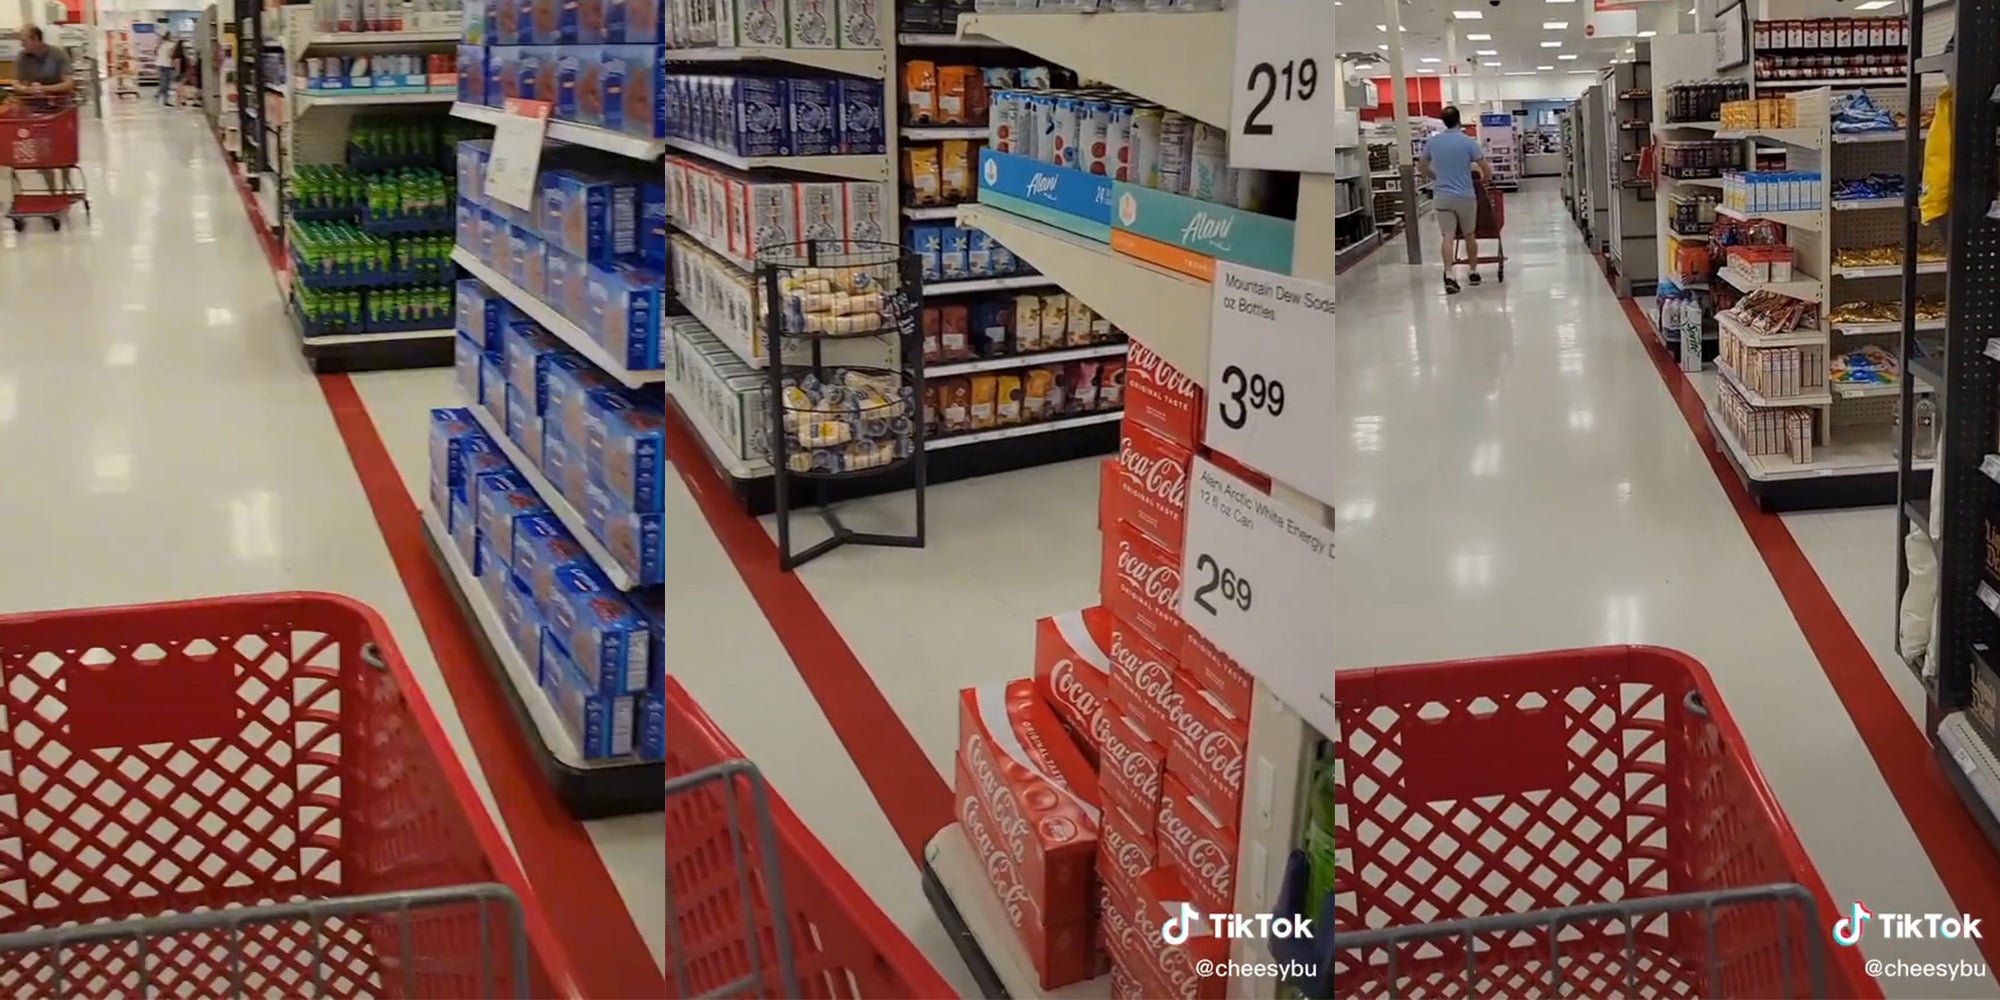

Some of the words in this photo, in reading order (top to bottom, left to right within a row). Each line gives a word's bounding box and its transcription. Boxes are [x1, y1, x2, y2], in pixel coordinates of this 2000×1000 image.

[1026, 172, 1060, 200] Alani
[1181, 211, 1234, 251] Alani
[1225, 272, 1273, 297] Mountain
[1275, 285, 1300, 304] Dew
[1223, 297, 1236, 310] oz
[1238, 298, 1275, 321] Bottles
[1685, 321, 1701, 358] Sprite
[1200, 488, 1211, 505] 12
[1233, 508, 1255, 531] Can
[1223, 483, 1253, 510] Arctic
[1254, 499, 1286, 529] White
[1286, 518, 1327, 555] Energy
